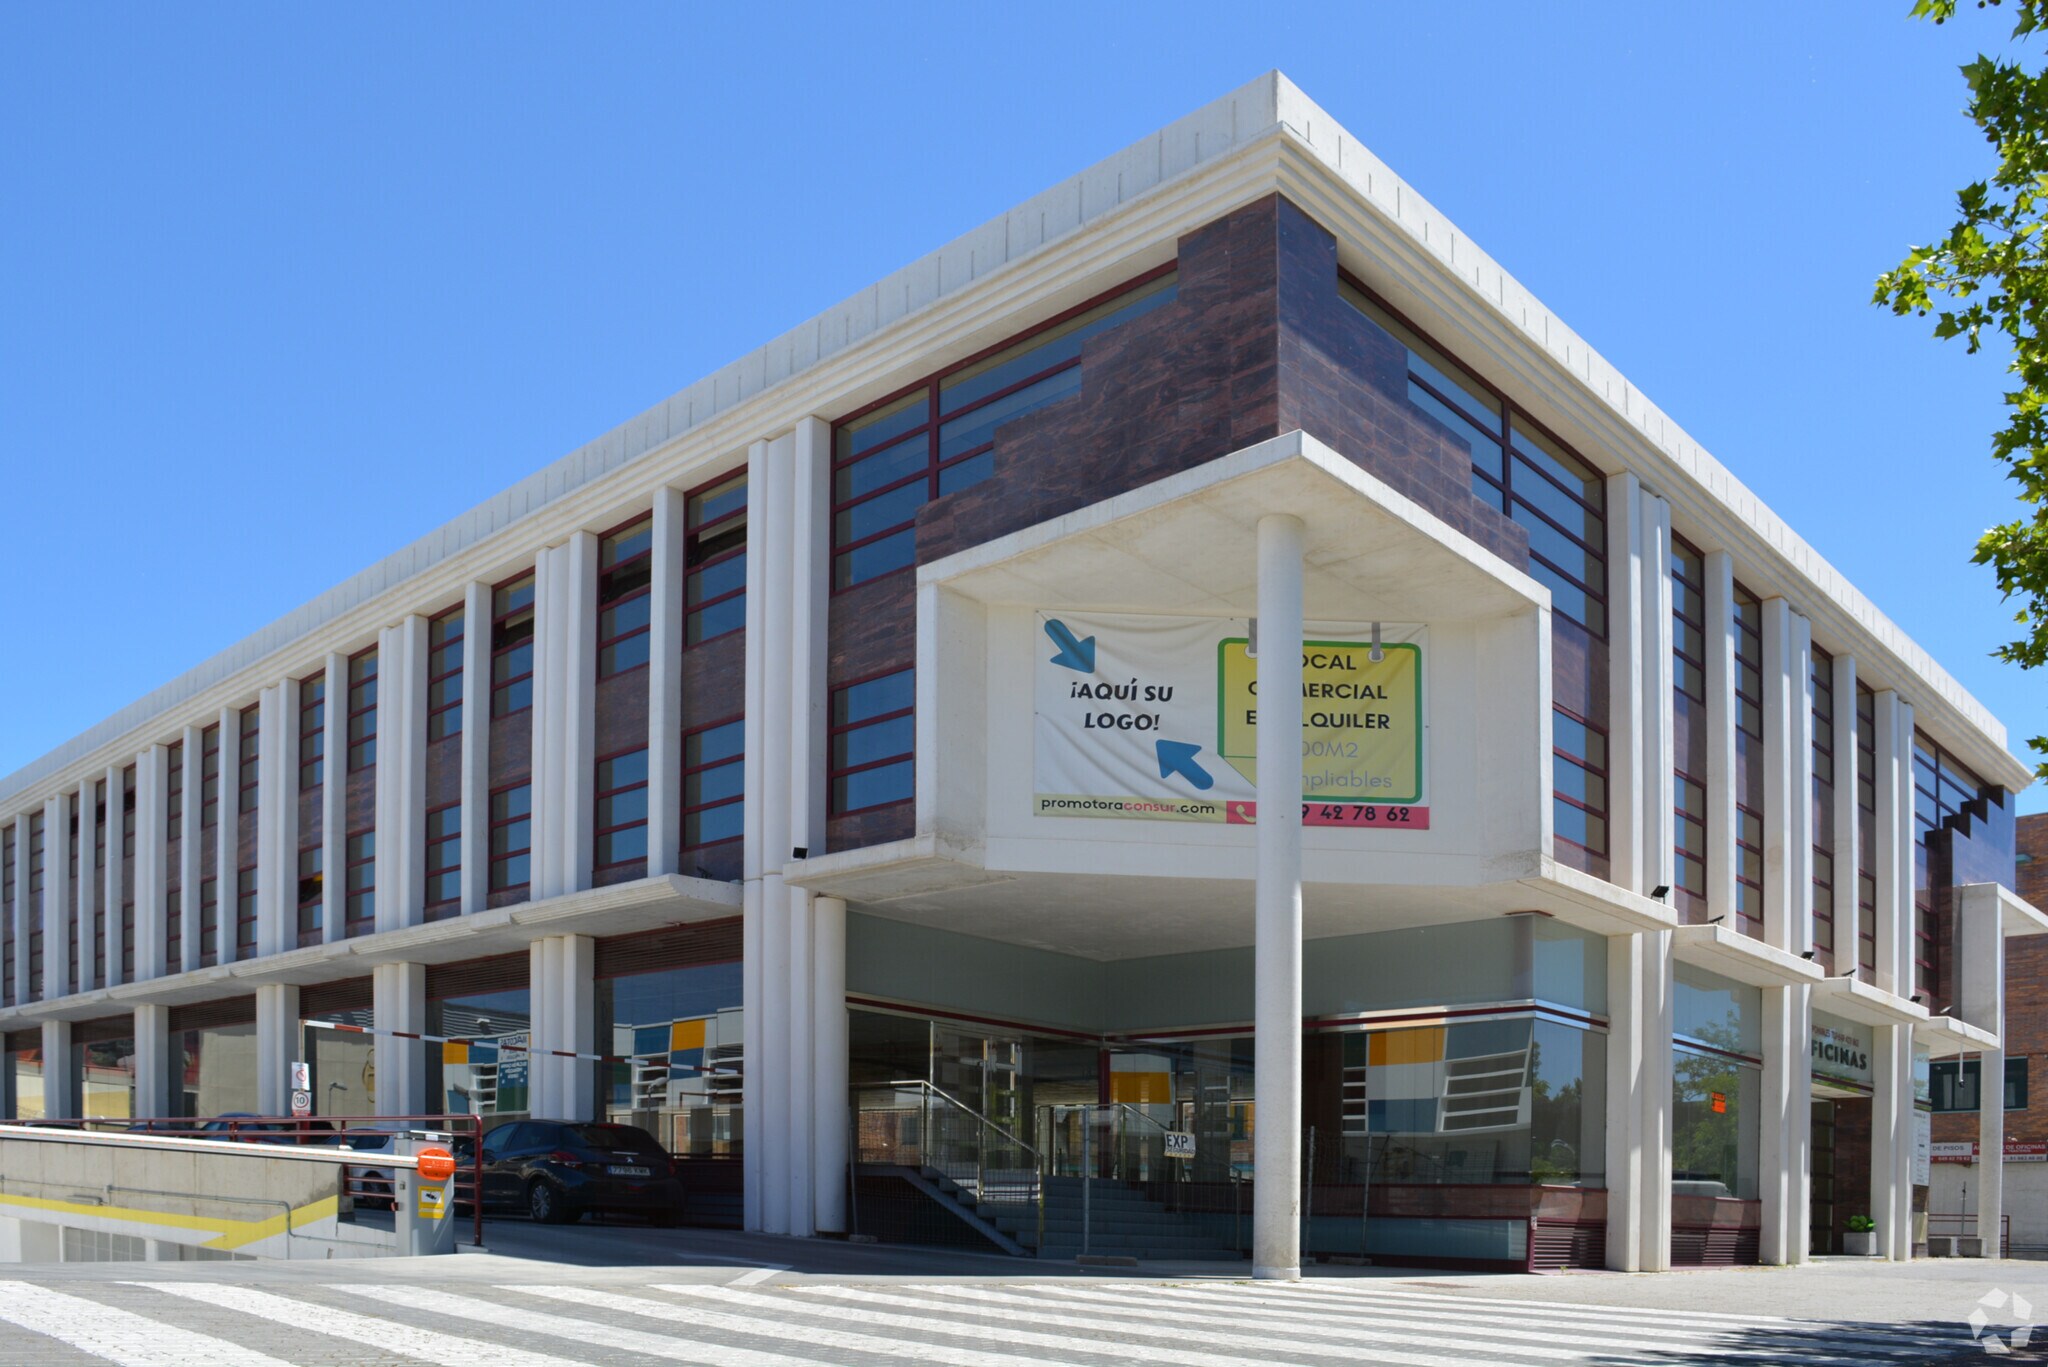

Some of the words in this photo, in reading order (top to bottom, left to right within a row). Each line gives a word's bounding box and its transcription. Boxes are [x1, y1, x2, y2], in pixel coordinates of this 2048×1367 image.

[1070, 678, 1137, 701] ¡AQUÍ
[1144, 686, 1173, 702] SU
[1248, 681, 1388, 700] CERCIAL
[1084, 713, 1160, 731] LOGO!
[1303, 712, 1391, 730] QUILER
[1041, 799, 1215, 815] promotoraconsur.com
[1320, 805, 1344, 821] 42
[1353, 806, 1377, 822] 78
[1386, 807, 1411, 823] 62
[1811, 1040, 1867, 1070] FICINAS
[296, 1096, 306, 1105] 10
[1166, 1134, 1189, 1149] EXP
[2005, 1143, 2015, 1151] DE
[2015, 1142, 2046, 1151] OFICINAS
